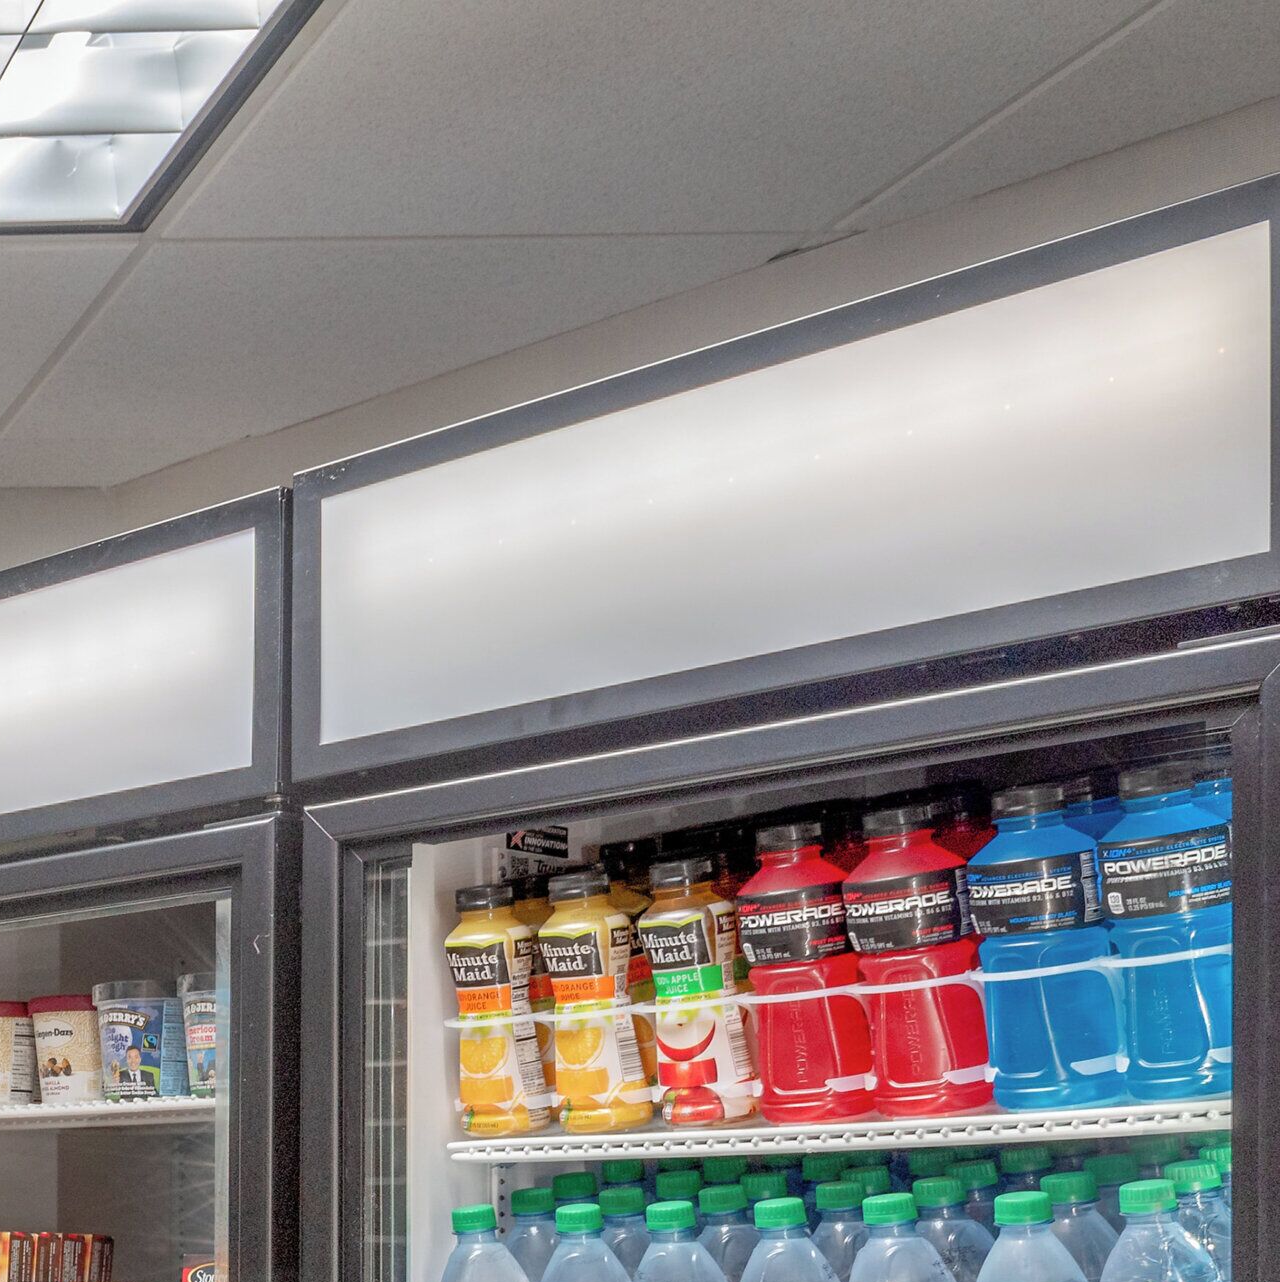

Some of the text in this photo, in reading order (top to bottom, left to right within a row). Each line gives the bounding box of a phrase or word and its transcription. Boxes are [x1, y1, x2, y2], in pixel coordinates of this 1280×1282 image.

[1103, 844, 1227, 877] POWERADE
[845, 890, 952, 918] POWERADE
[741, 901, 845, 929] POWERADE
[539, 942, 591, 956] Minute
[642, 932, 698, 949] Minute
[447, 952, 498, 967] Minute
[650, 945, 692, 964] Maid
[546, 956, 586, 973] Maid
[453, 966, 494, 983] Maid
[466, 989, 501, 1001] ORANGE
[560, 981, 595, 992] ORANGE
[665, 983, 689, 994] JUICE
[466, 1002, 487, 1010] JUICE
